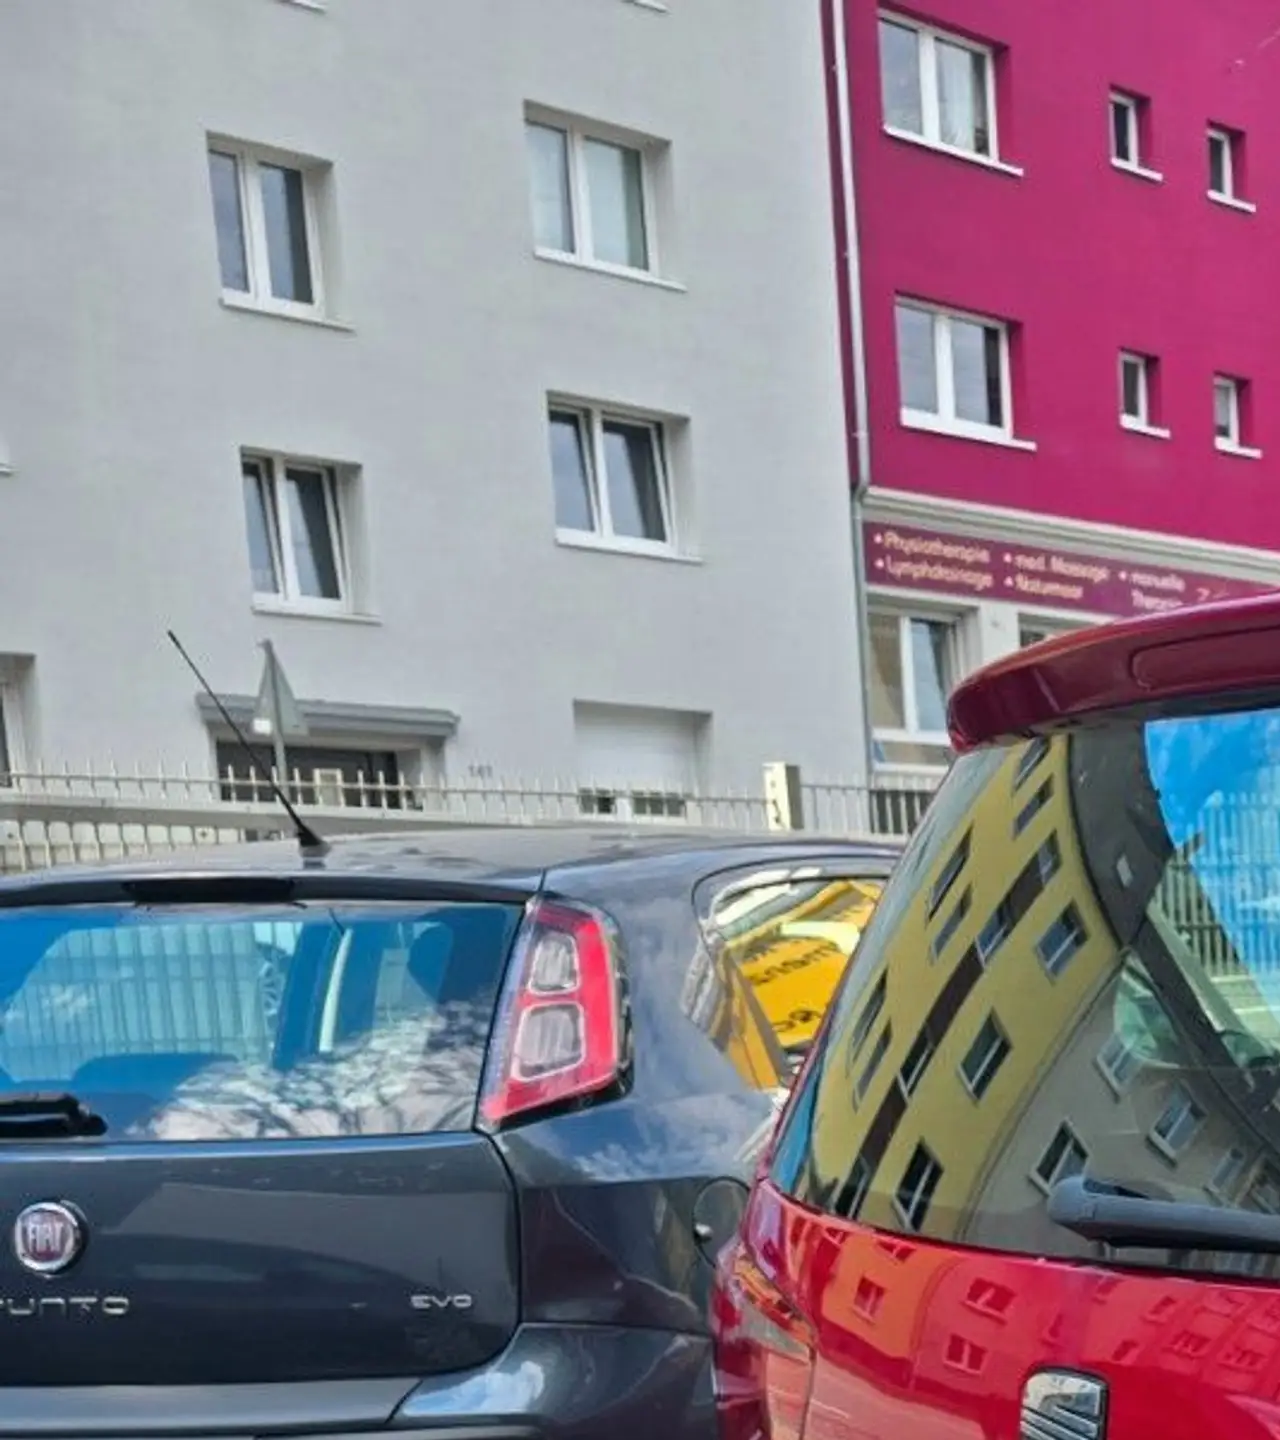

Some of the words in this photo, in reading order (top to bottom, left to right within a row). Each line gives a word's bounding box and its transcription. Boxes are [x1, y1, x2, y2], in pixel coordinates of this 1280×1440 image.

[27, 1222, 63, 1253] FIAT
[0, 1296, 130, 1316] UNTO
[410, 1293, 473, 1309] EVO
